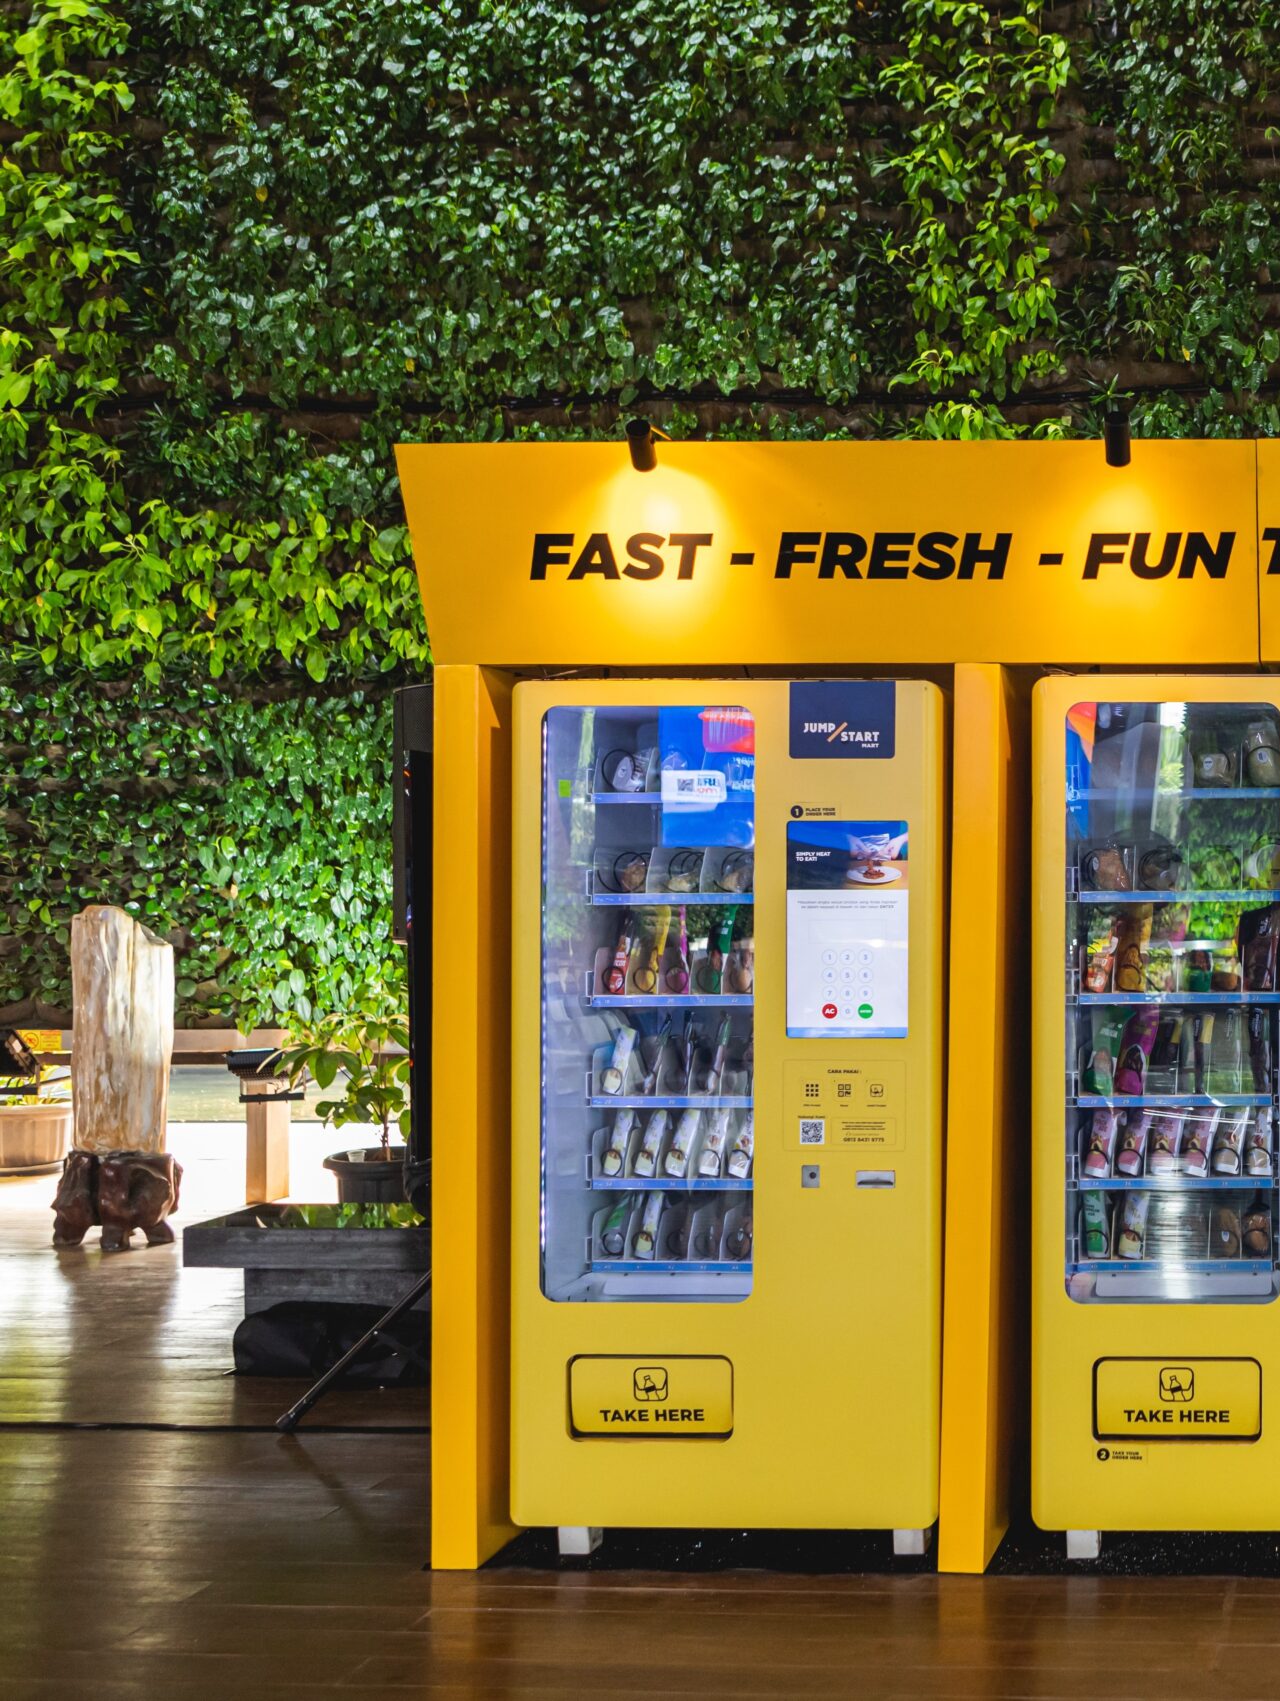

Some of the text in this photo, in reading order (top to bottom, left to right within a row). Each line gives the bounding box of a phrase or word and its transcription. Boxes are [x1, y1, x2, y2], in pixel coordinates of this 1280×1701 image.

[529, 532, 713, 581] FAST
[730, 552, 755, 565] -
[774, 531, 1013, 580] FRESH
[1038, 553, 1064, 566] -
[1081, 531, 1237, 580] FUN
[803, 722, 880, 742] JUMP START
[600, 1408, 704, 1422] TAKE HERE
[1124, 1410, 1230, 1423] TAKE HERE
